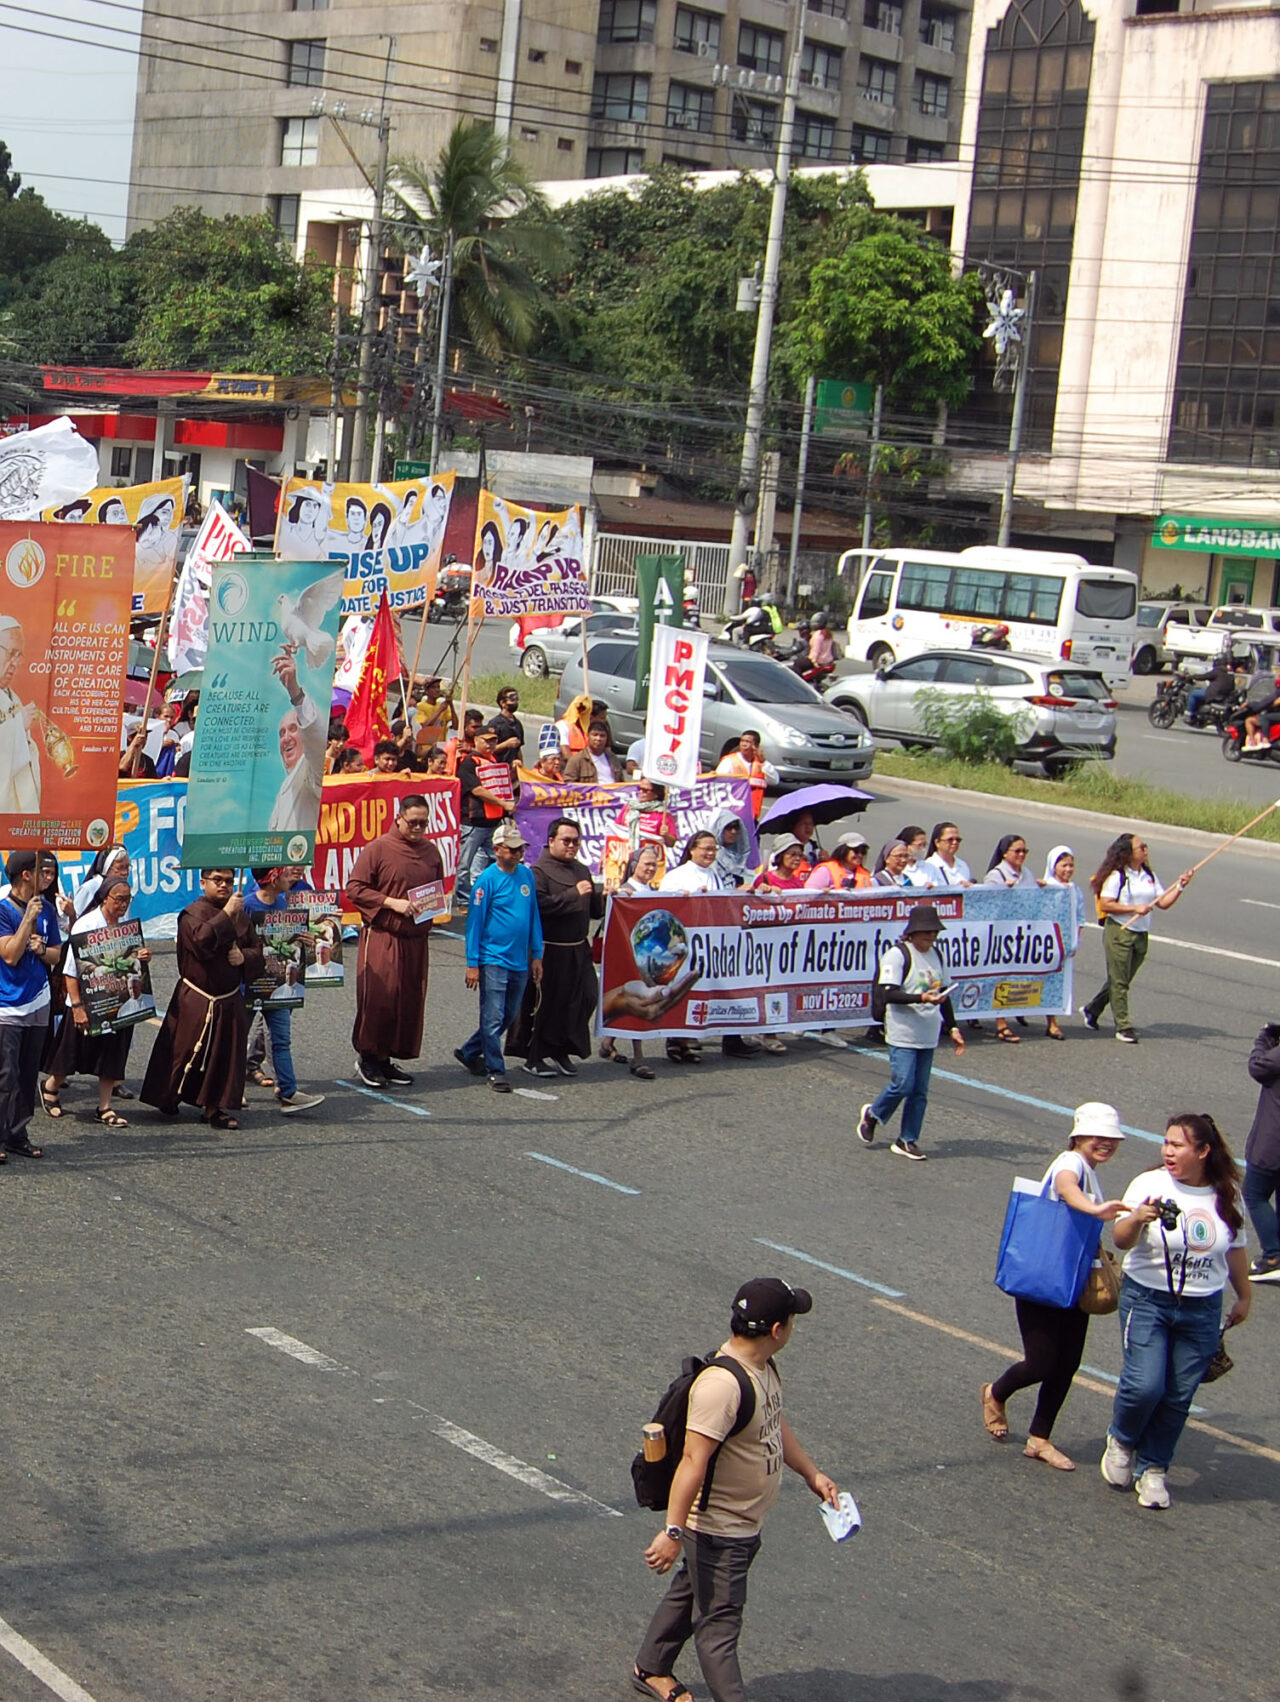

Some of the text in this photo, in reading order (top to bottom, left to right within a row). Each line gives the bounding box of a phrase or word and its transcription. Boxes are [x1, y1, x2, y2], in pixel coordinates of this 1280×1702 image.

[55, 554, 115, 578] FIRE
[388, 543, 429, 573] UP
[554, 557, 581, 581] UP
[361, 577, 387, 595] FOR
[374, 585, 426, 609] JUSTICE
[485, 600, 495, 615] &
[498, 599, 530, 615] JUST
[53, 622, 126, 635] ALL OF US CAN
[212, 621, 279, 644] WIND
[51, 635, 125, 648] COOPERATE AS
[45, 649, 124, 662] INSTRUMENTS OF
[29, 662, 122, 675] GOD FOR THE CARE
[54, 677, 69, 688] OF
[207, 690, 260, 701] BECAUSE ALL
[206, 703, 270, 714] CREATURES ARE
[689, 783, 745, 808] FUEL
[361, 798, 388, 842] UP
[308, 891, 337, 904] now
[264, 912, 308, 924] act now
[743, 901, 893, 925] Speed Up Climate Emergency
[88, 921, 139, 945] act now
[689, 923, 1055, 983] Global Day of Action Justice
[803, 987, 863, 1011] NOV 15 2024
[1173, 1253, 1213, 1270] RGHTS
